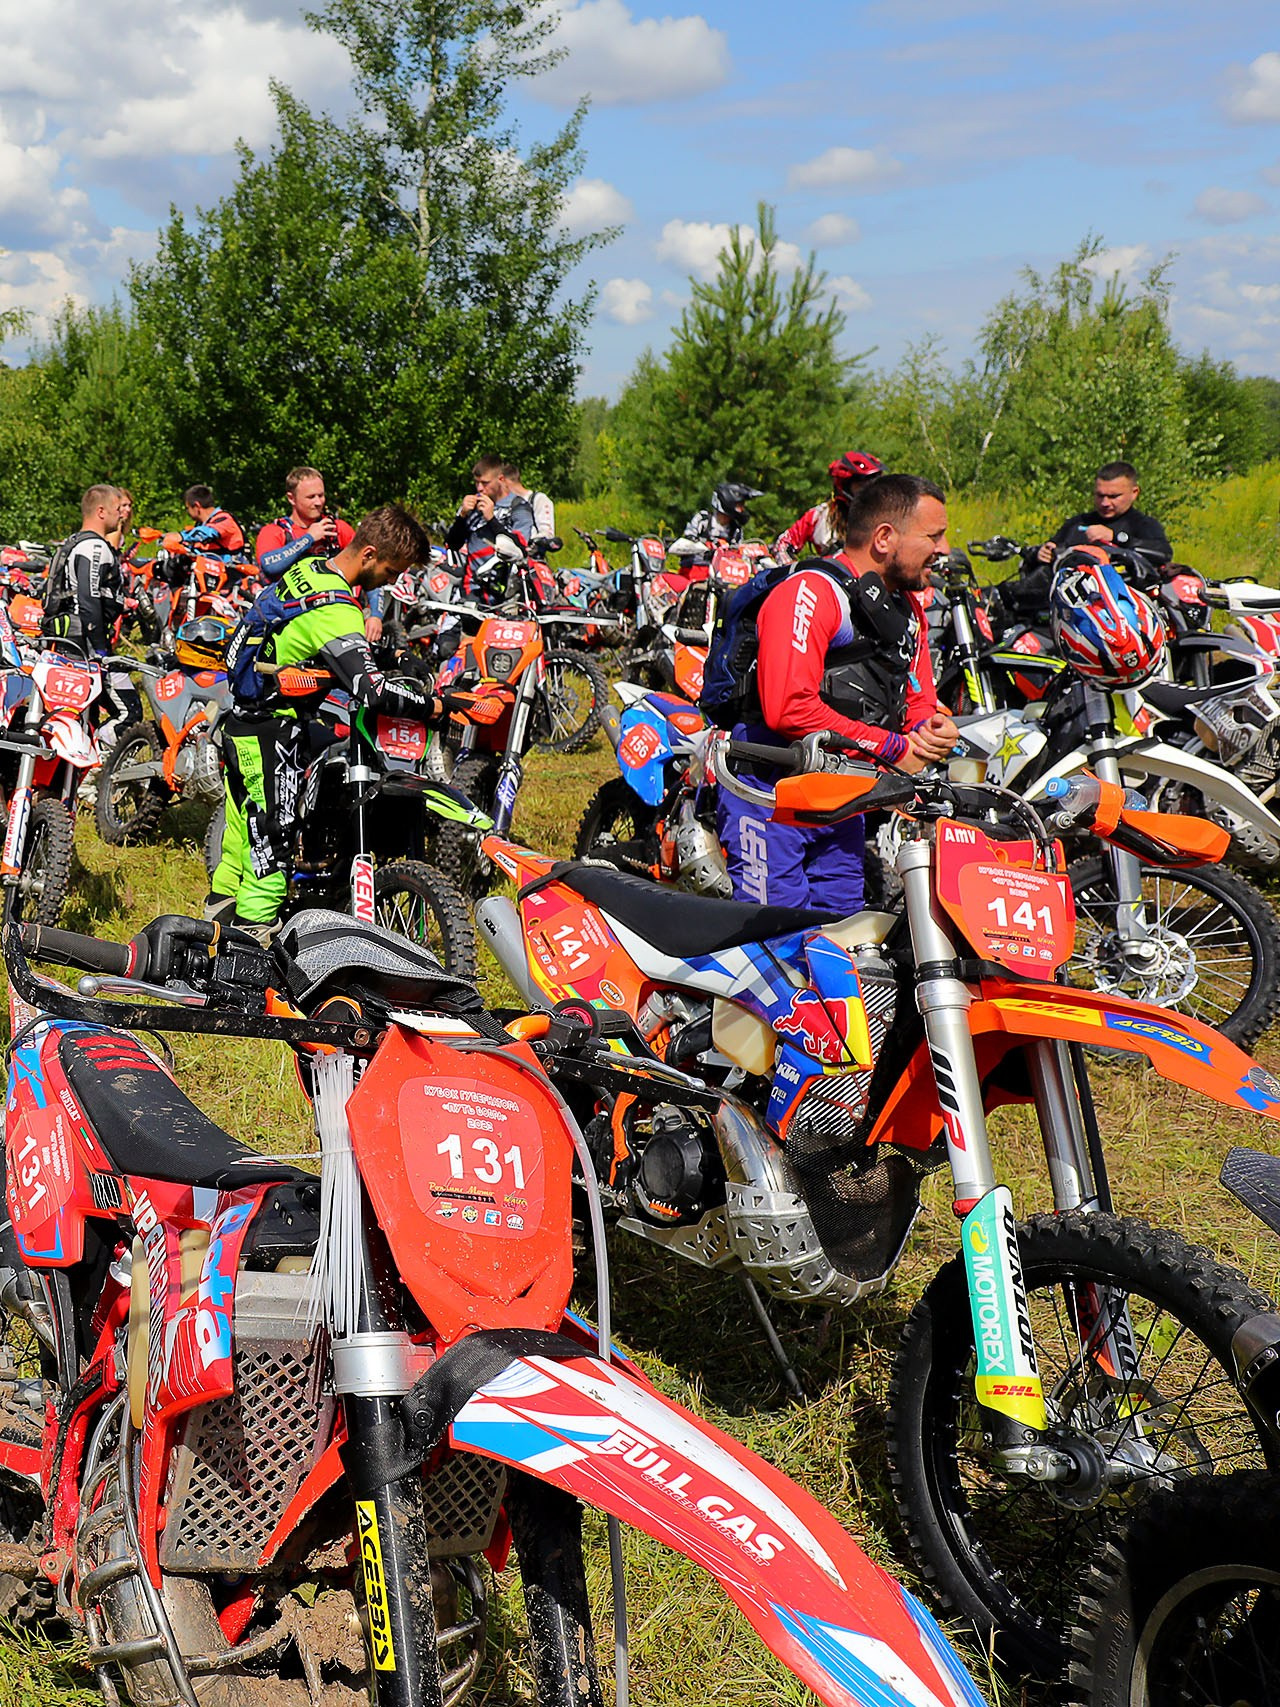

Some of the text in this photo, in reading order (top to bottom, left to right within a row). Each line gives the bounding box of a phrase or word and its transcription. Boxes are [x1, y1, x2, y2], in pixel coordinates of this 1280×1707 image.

[264, 552, 283, 565] FLY
[792, 579, 818, 654] LEATT
[55, 680, 84, 696] 174
[691, 671, 704, 685] 16
[388, 728, 421, 744] 154
[630, 735, 648, 758] 156
[945, 828, 976, 844] AMV
[738, 815, 769, 906] LEATT
[355, 862, 375, 922] KEN
[484, 918, 498, 936] KTM
[987, 897, 1054, 935] 141
[553, 925, 590, 970] 141
[1114, 1020, 1204, 1053] ACERBIS
[776, 1062, 801, 1085] KTM
[424, 1085, 520, 1112] КУБОК ГУБЕРНАТОРА
[467, 1118, 494, 1132] 2023
[18, 1135, 47, 1210] 131
[436, 1134, 525, 1189] 131
[1004, 1205, 1038, 1374] DUNLOP
[972, 1256, 1007, 1373] MOTOREX
[988, 1385, 1040, 1397] DHL
[597, 1429, 786, 1560] FULL GAS
[641, 1473, 697, 1512] CHARGED
[695, 1508, 715, 1525] BY
[358, 1507, 389, 1667] ACERBIS
